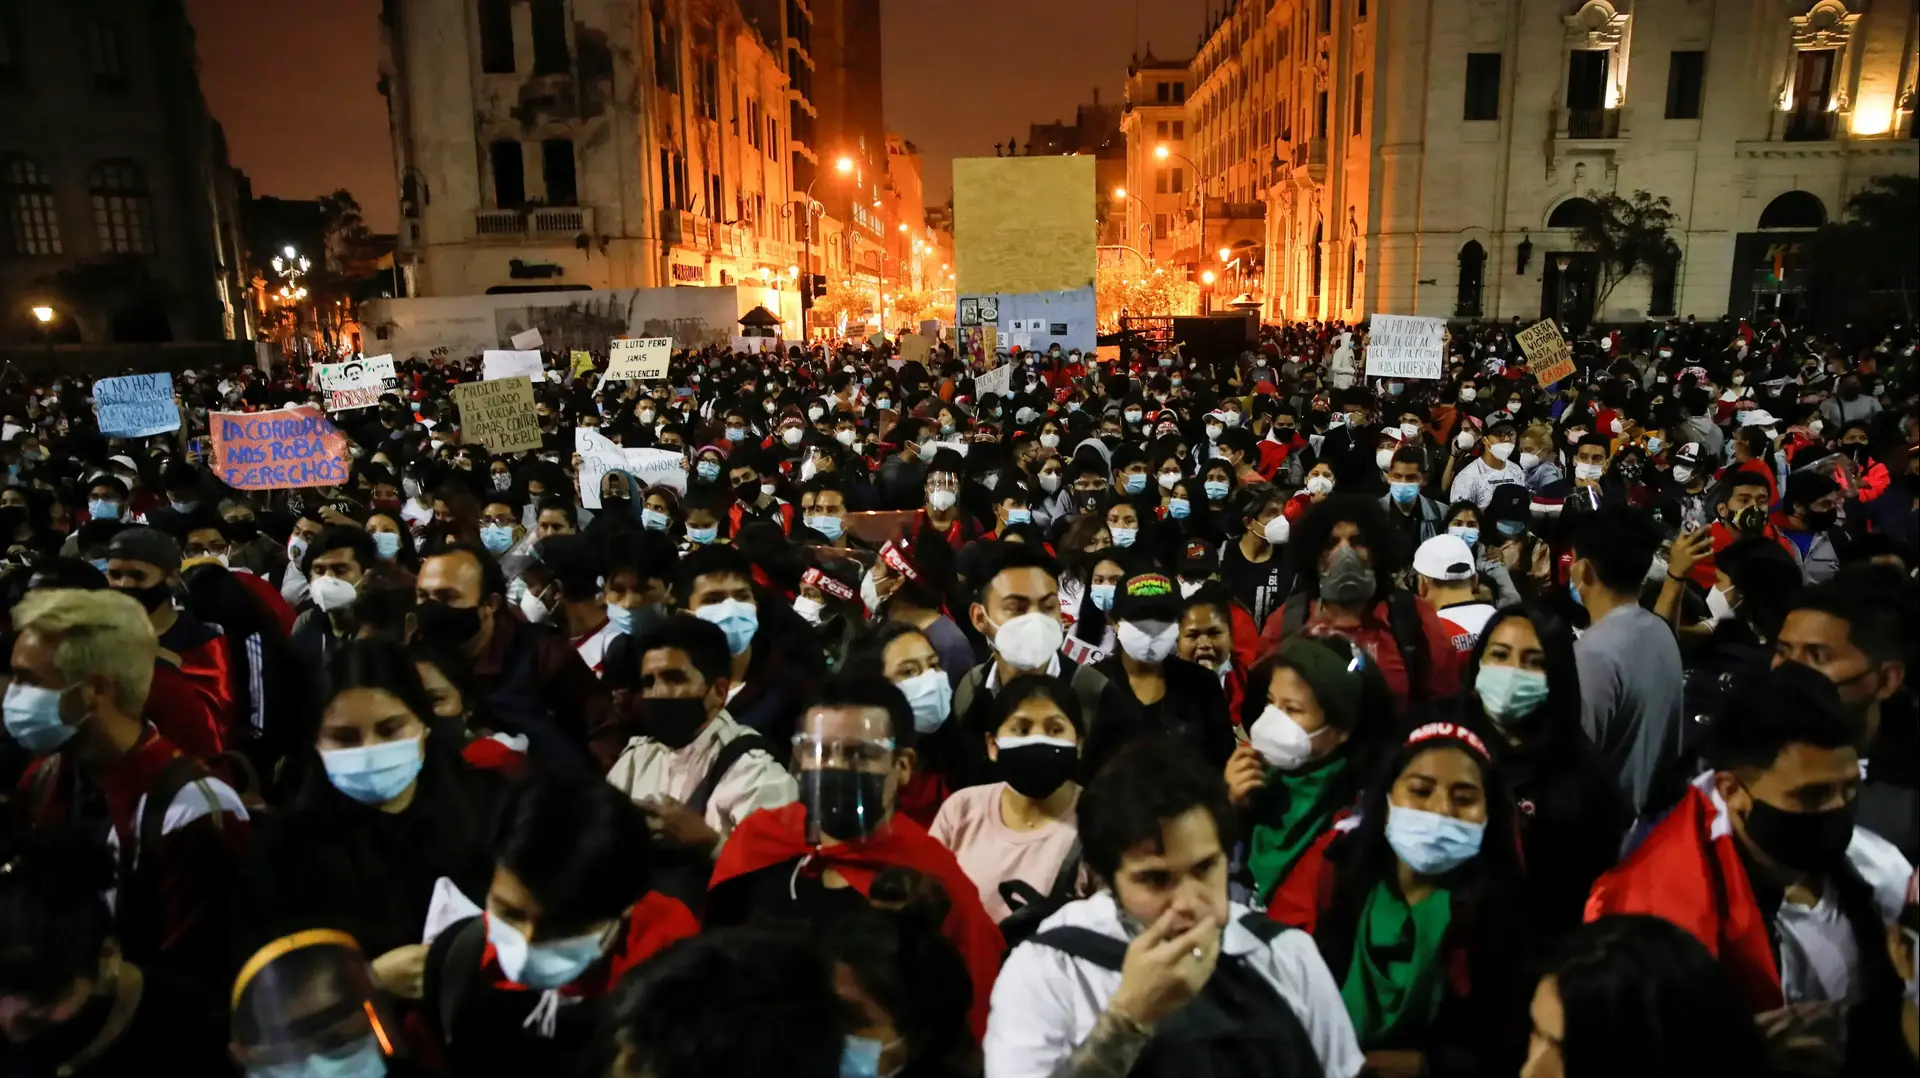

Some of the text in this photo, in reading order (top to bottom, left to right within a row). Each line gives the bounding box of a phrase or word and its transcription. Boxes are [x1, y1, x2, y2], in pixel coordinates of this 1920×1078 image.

[612, 338, 667, 349] DE LUTO PERO
[1521, 331, 1533, 343] NO
[1527, 330, 1560, 351] VICTORIA
[1557, 338, 1563, 348] Q
[624, 353, 647, 362] JAMAS
[1528, 346, 1553, 361] HASTA
[611, 369, 660, 379] EN SILENCIO
[96, 373, 156, 396] SI NO HAY
[505, 377, 522, 390] SEA
[465, 399, 479, 412] EL
[518, 400, 534, 414] LAS
[506, 412, 539, 432] CONTRA
[500, 426, 540, 447] PUEBLO
[227, 437, 327, 464] NOS ROBA
[224, 456, 347, 487] DERECHOS
